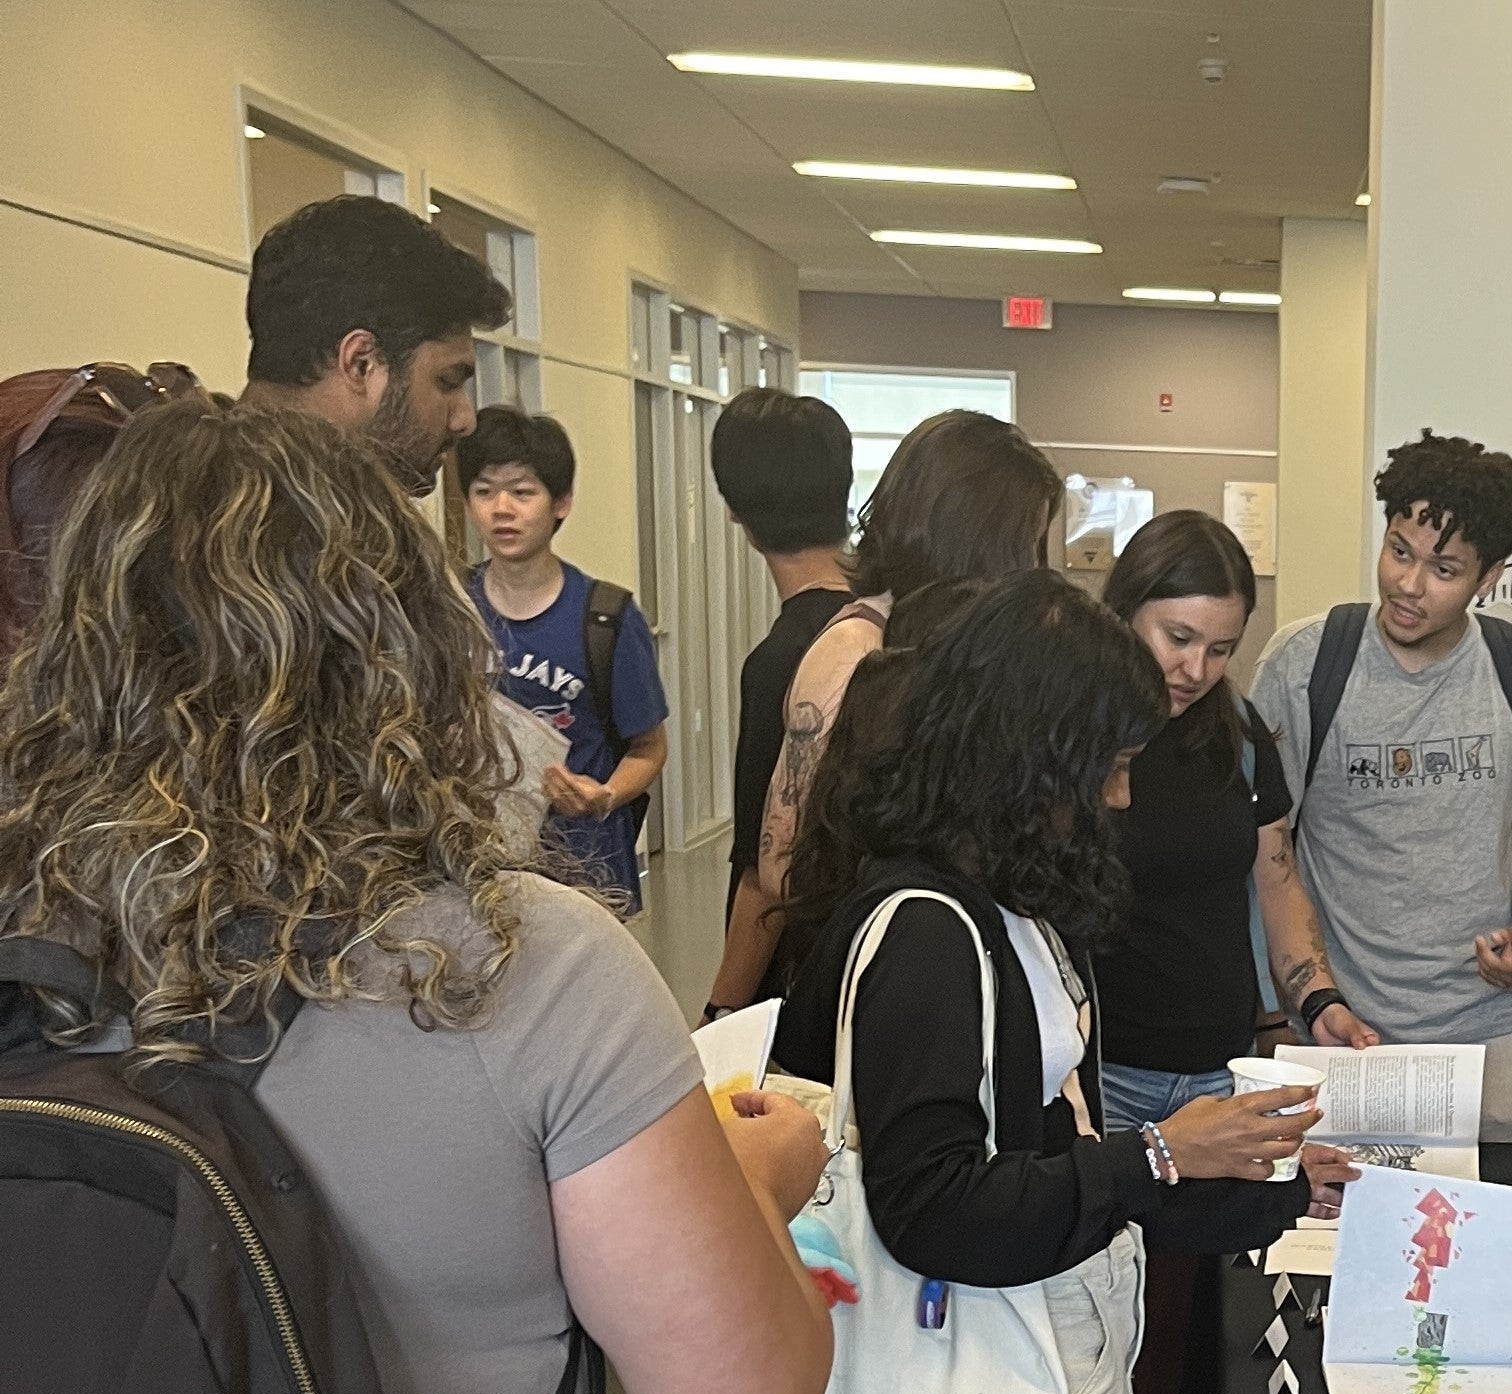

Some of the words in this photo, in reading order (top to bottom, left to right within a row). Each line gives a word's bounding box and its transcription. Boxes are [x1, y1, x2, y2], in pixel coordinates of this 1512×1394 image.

[1009, 299, 1043, 325] EXIT
[509, 653, 585, 701] JAYS
[1347, 775, 1442, 790] TORONTO
[1457, 769, 1497, 783] ZOO
